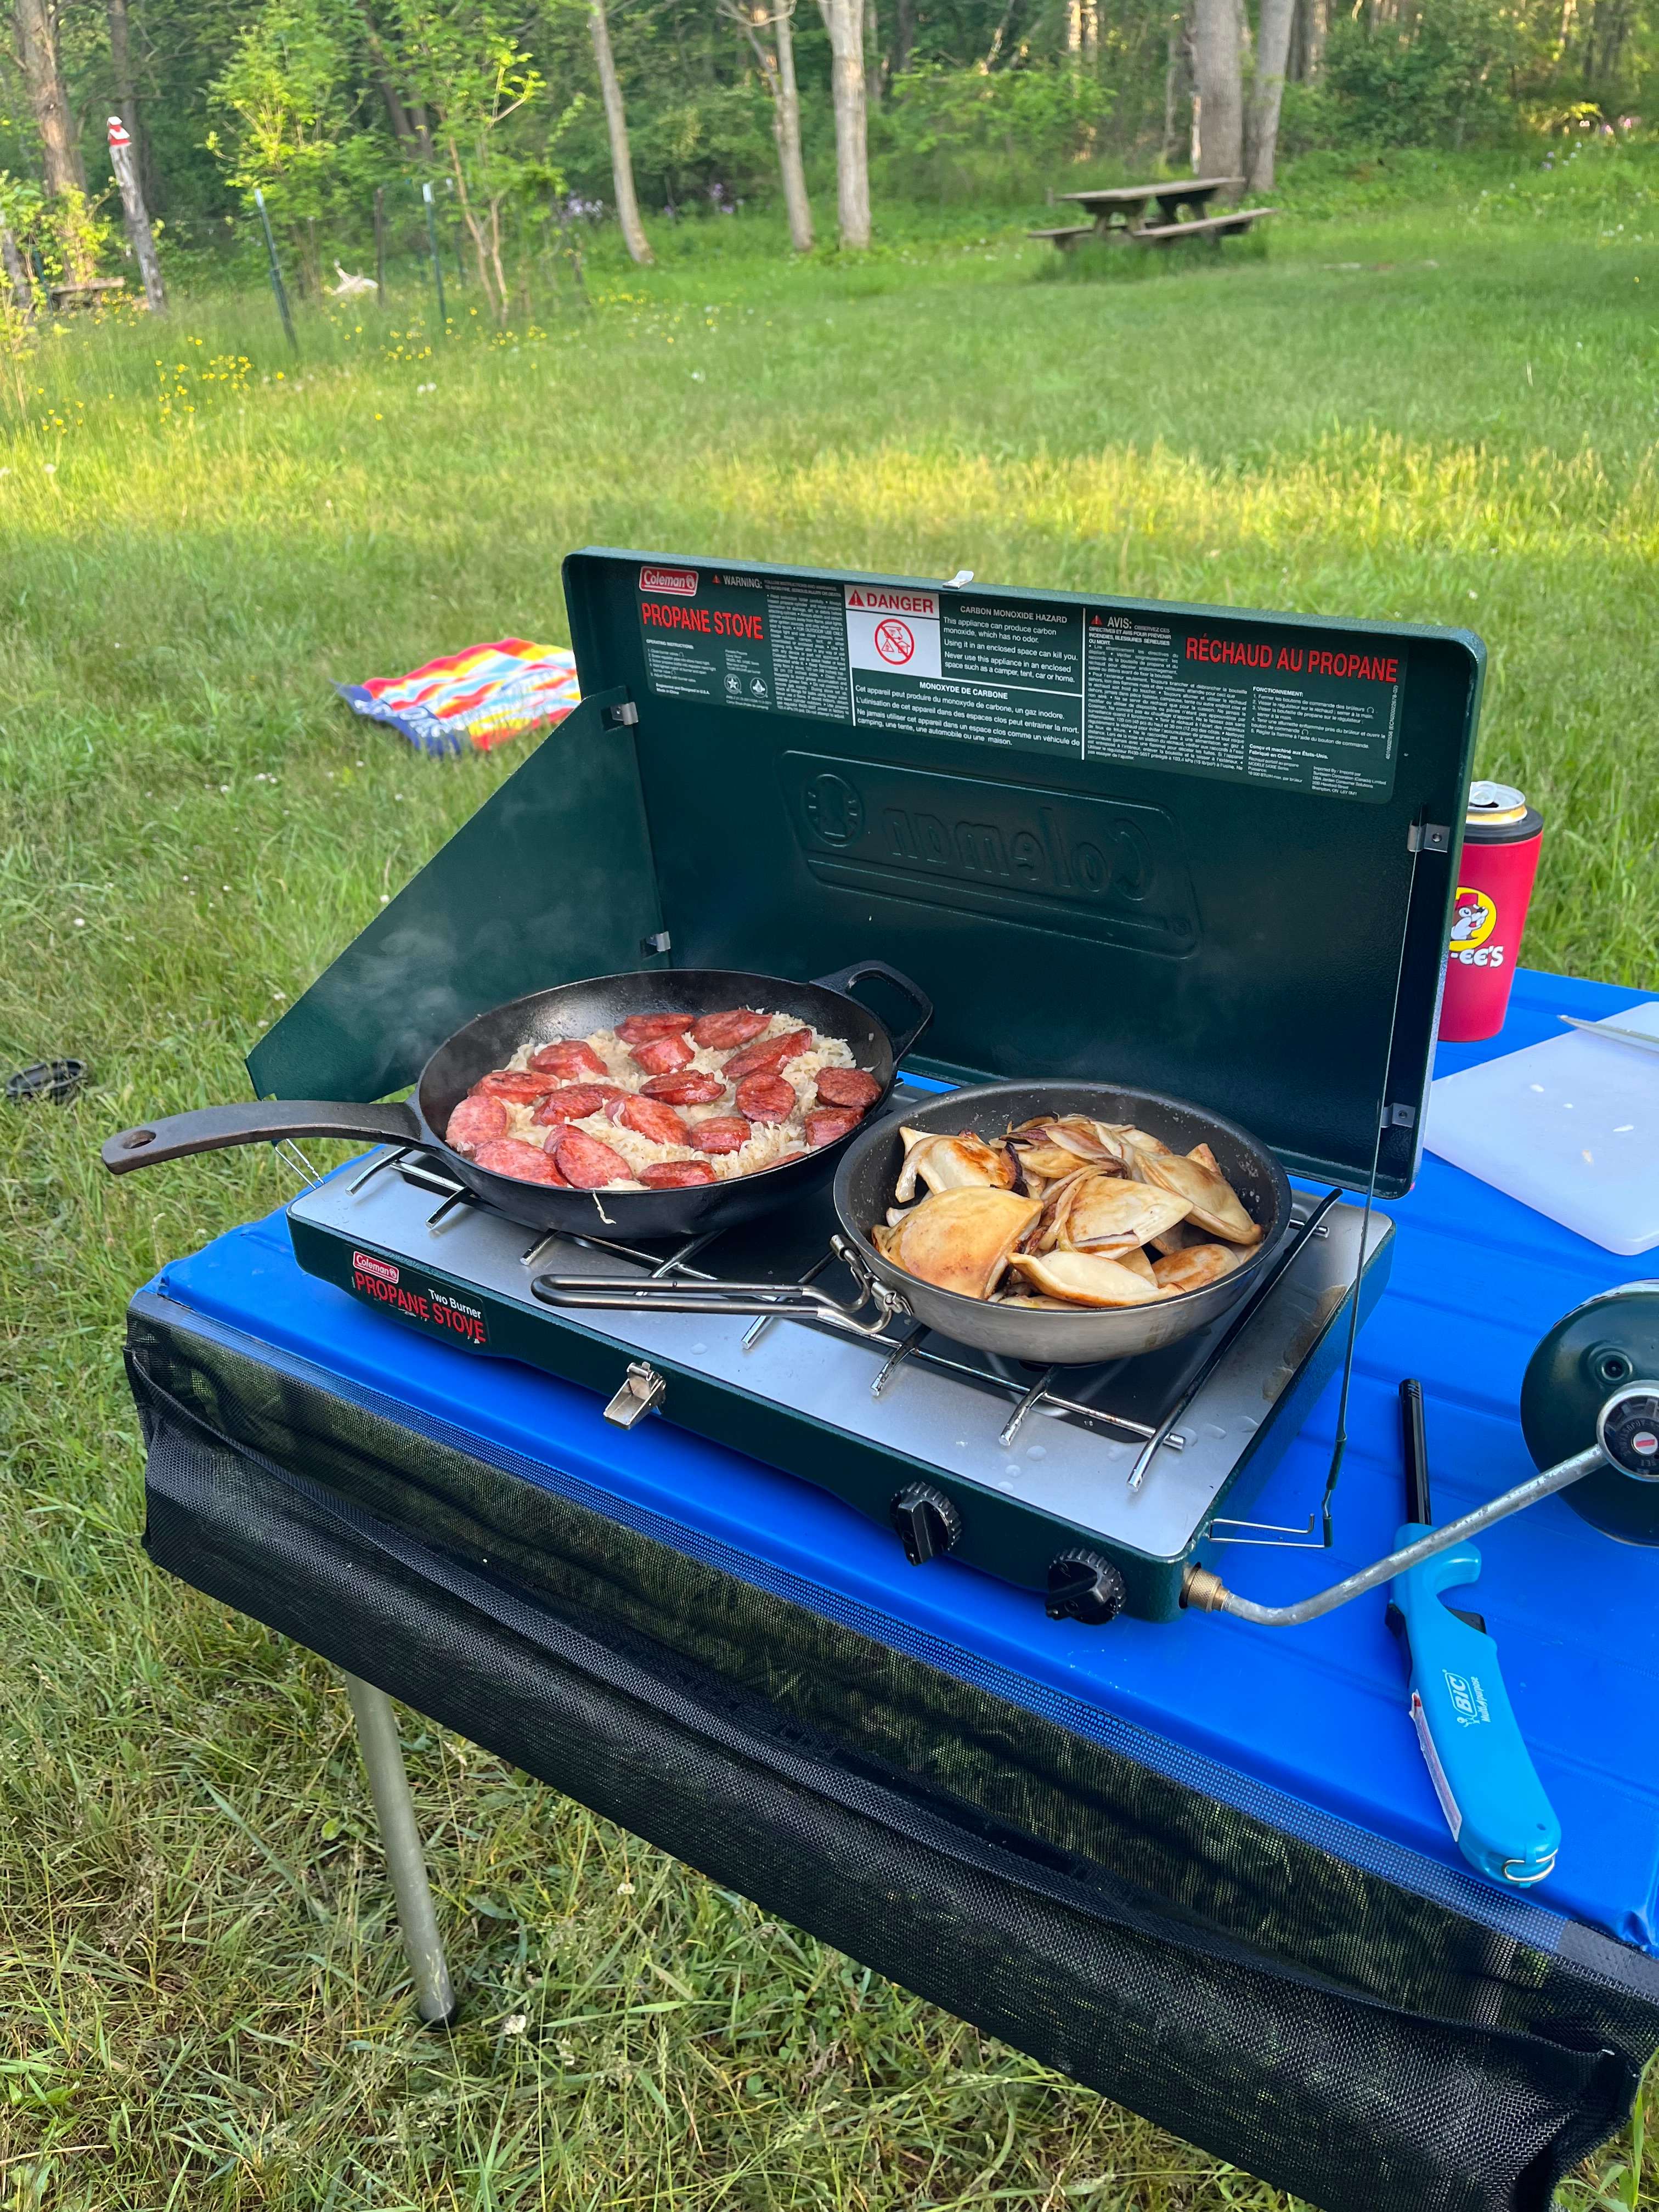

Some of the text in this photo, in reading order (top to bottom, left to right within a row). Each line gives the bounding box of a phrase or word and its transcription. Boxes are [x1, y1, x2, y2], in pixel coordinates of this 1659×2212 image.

[644, 571, 686, 588] Coleman
[723, 575, 763, 589] WARNING:
[866, 592, 934, 614] DANGER
[641, 602, 764, 640] PROPANE STOVE
[961, 606, 1067, 623] CARBON MONOXIDE HAZARD
[1107, 616, 1132, 629] AVIS:
[944, 628, 977, 636] monoxide,
[1033, 628, 1056, 636] carbon
[944, 639, 962, 648] Using
[991, 658, 1022, 667] appliance
[1041, 664, 1071, 672] enclosed
[1186, 633, 1272, 668] RÉCHAUD
[1278, 647, 1302, 673] AU
[1308, 651, 1398, 682] PROPANE
[1020, 670, 1034, 678] tent,
[1055, 674, 1075, 682] home.
[920, 682, 960, 693] MONOXYDE
[973, 689, 1008, 699] CARBONE
[943, 698, 974, 707] monoxyde
[1039, 710, 1064, 719] inodore.
[967, 713, 992, 721] espaces
[857, 718, 884, 727] camping,
[898, 723, 915, 731] tente,
[929, 729, 962, 738] automobile
[1043, 735, 1069, 744] véhicule
[357, 1254, 390, 1276] Coleman
[354, 1271, 486, 1342] PROPANE STOVE
[428, 1289, 481, 1319] Two Burner
[1448, 1675, 1473, 1713] BIC
